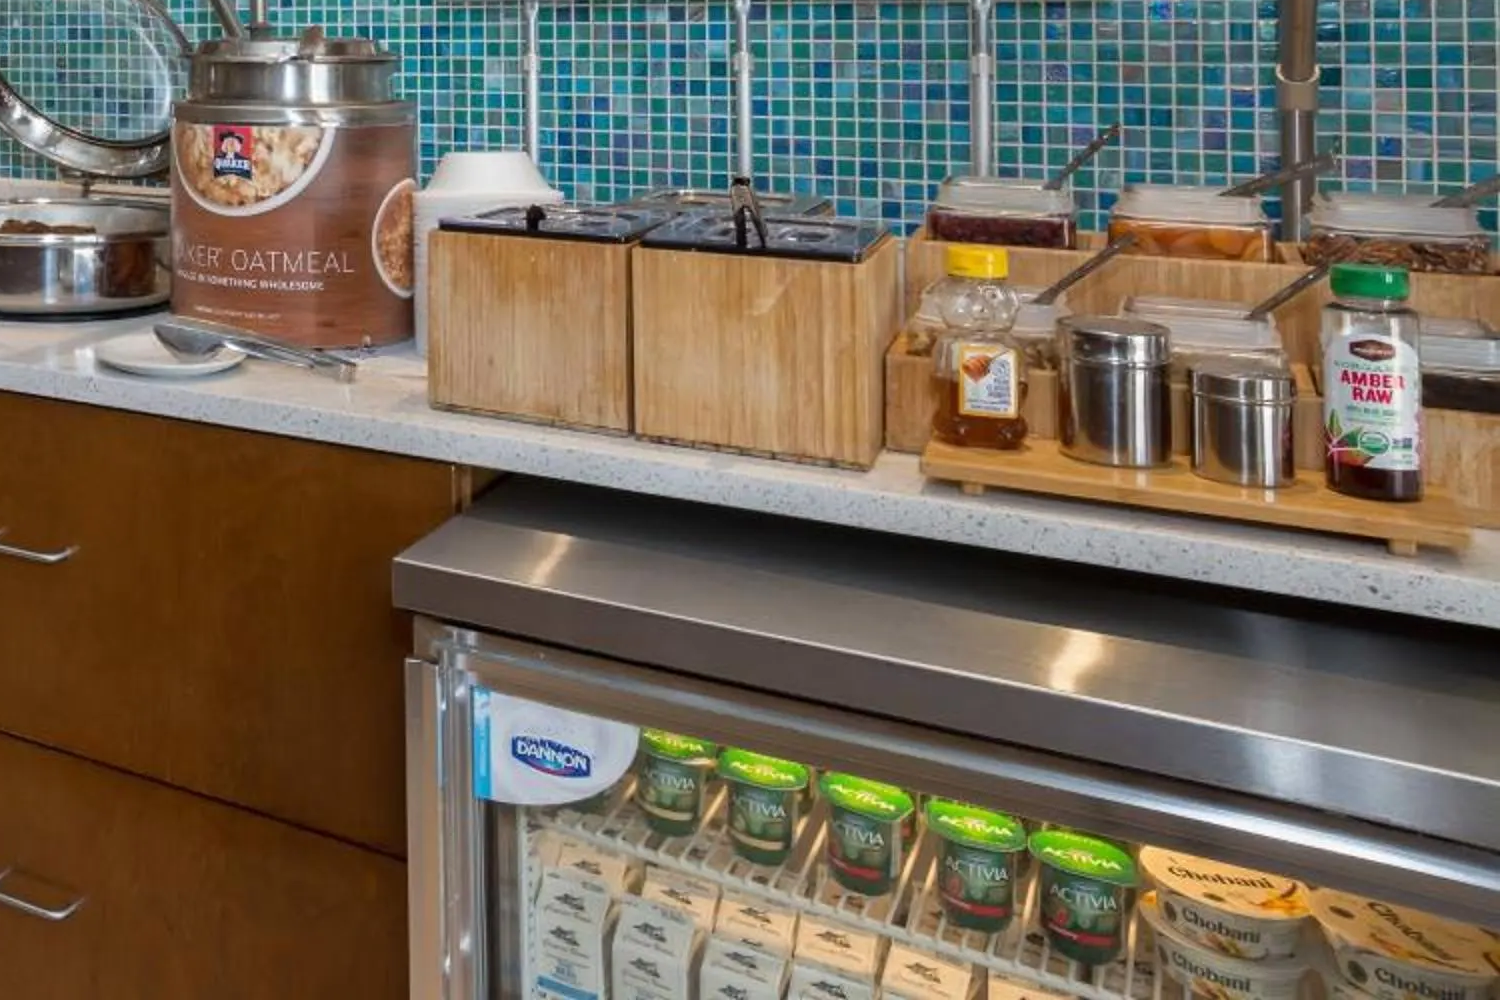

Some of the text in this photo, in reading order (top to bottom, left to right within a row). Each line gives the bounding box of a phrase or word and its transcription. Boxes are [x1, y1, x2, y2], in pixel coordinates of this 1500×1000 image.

[230, 248, 355, 273] OATMEAL
[1351, 387, 1393, 404] RAW
[516, 740, 588, 770] DANNON
[945, 855, 1009, 882] ACTIVIA
[1167, 866, 1276, 889] Chobani
[1050, 884, 1117, 911] ACTIVIA
[1182, 907, 1261, 944] Chobani
[1172, 951, 1251, 993] Chobani
